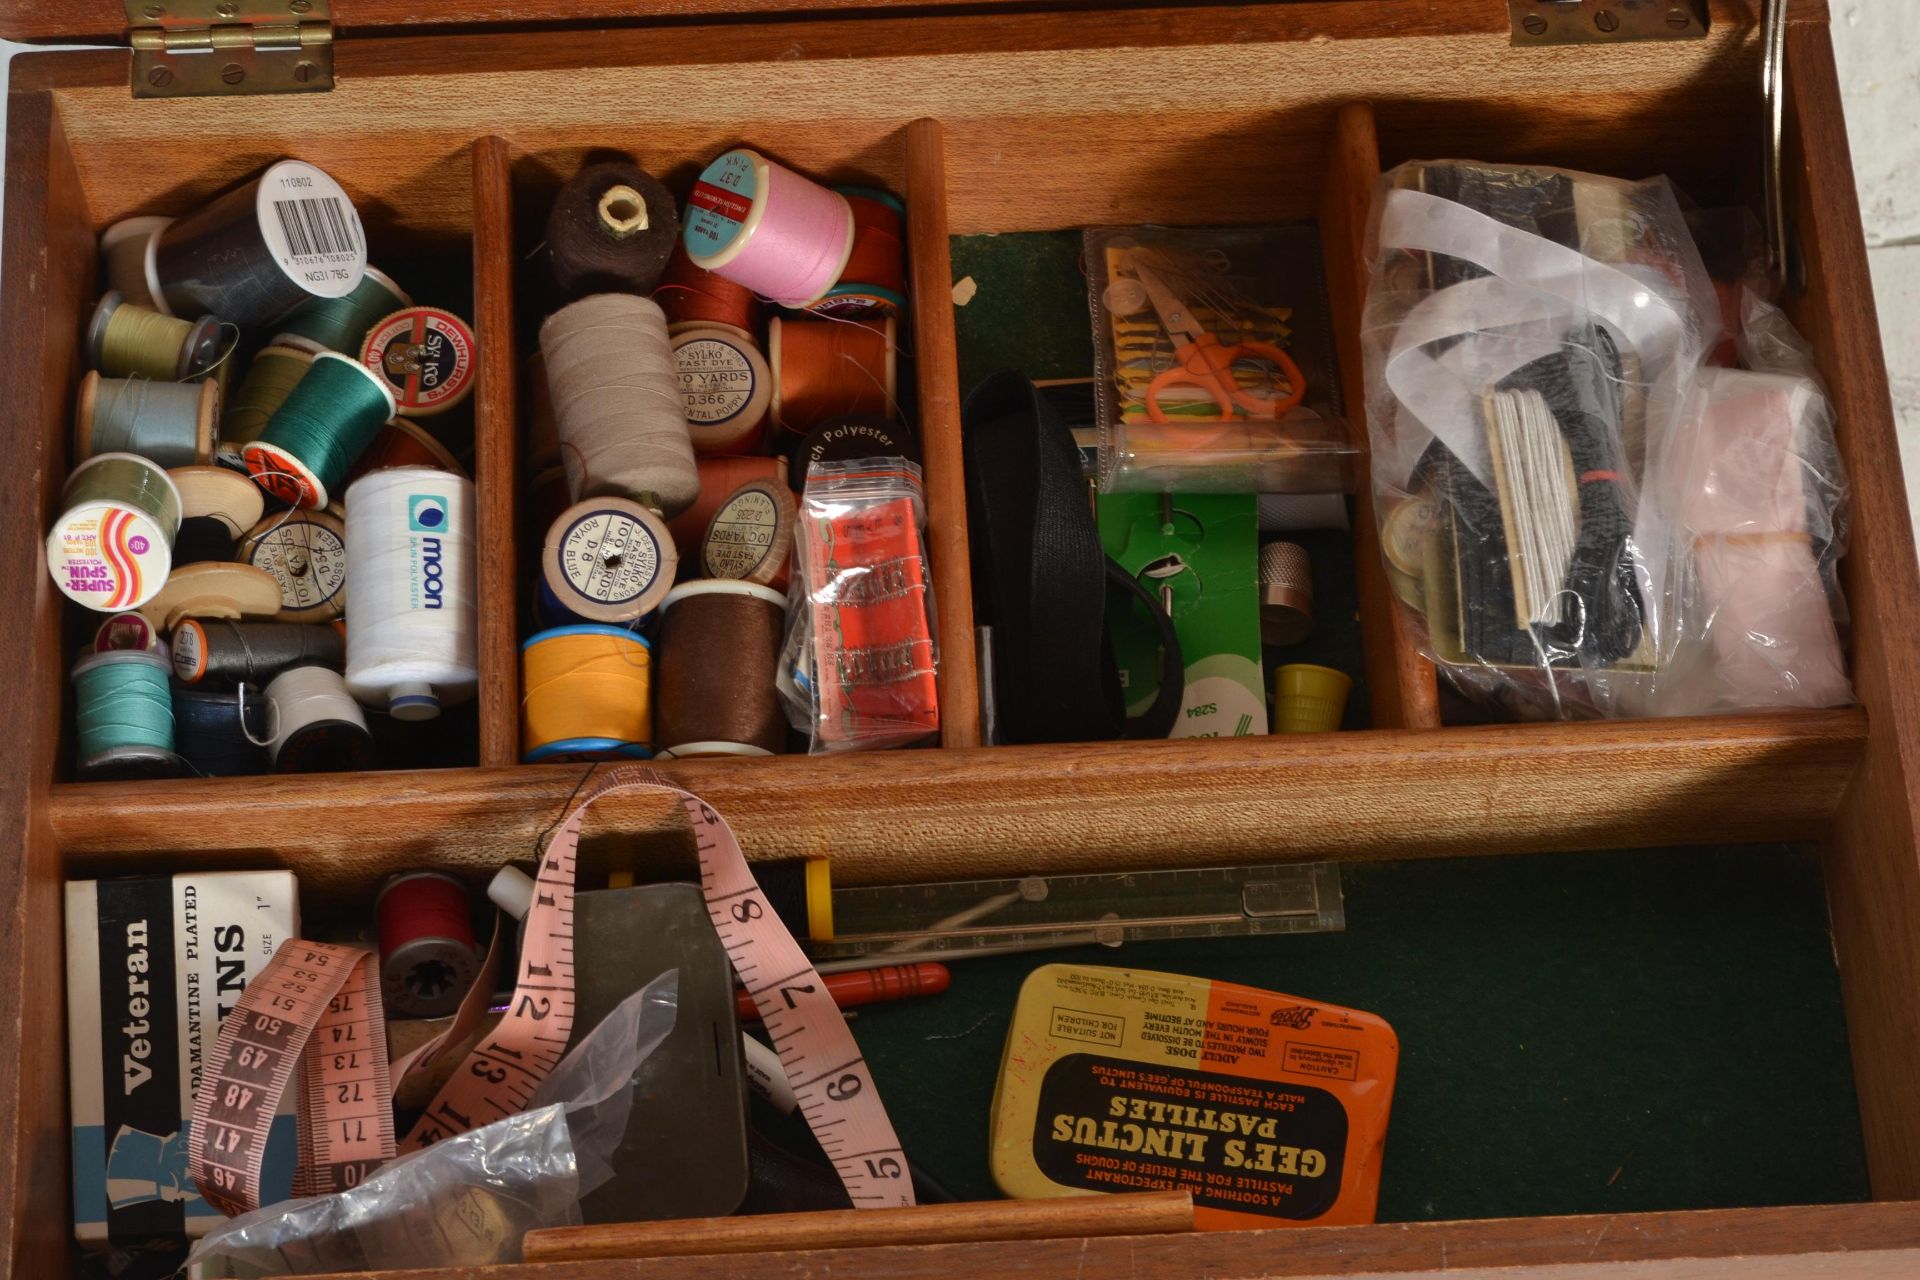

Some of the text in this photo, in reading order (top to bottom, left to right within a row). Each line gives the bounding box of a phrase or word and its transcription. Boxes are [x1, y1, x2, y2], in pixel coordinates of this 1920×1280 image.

[726, 156, 749, 171] PINK
[281, 177, 312, 187] 110802
[708, 230, 720, 241] 100
[332, 269, 348, 278] 7BG
[426, 322, 467, 399] DEWHURST'S
[689, 350, 722, 359] SYLKO
[699, 372, 748, 383] YARDS
[688, 394, 725, 405] D.366
[717, 394, 743, 417] POPPY
[823, 425, 894, 446] Polyester
[615, 520, 632, 549] 100
[712, 530, 745, 542] YARDS
[316, 531, 343, 587] MOSS GREEN
[566, 520, 599, 579] ROYAL BLUE
[582, 539, 598, 563] D.8
[627, 540, 641, 567] FAST
[641, 535, 655, 583] DEWHURST
[716, 550, 754, 559] FAST DYE
[423, 538, 444, 609] moon
[631, 551, 647, 583] SYLKO
[720, 560, 744, 568] SYLKO
[65, 579, 115, 591] SUPER-
[277, 570, 288, 594] FAST
[296, 577, 310, 604] 100
[410, 560, 418, 608] POLYESTER
[619, 569, 631, 590] DYE
[614, 588, 636, 600] SONS
[180, 631, 193, 646] 278
[1186, 703, 1218, 718] S284
[731, 898, 764, 924] 8
[263, 933, 273, 955] SIZE
[304, 951, 330, 966] 54
[281, 981, 308, 994] 52
[292, 970, 319, 983] 53
[185, 885, 201, 1102] ADAMANTINE PLATED
[270, 996, 297, 1010] 51
[328, 994, 354, 1014] 75
[779, 984, 816, 1010] 7
[125, 919, 152, 1096] Veteran
[1269, 1002, 1318, 1032] Boots
[254, 1016, 283, 1036] 50
[1056, 1024, 1117, 1040] NOT SUITABLE
[1057, 1014, 1118, 1030] FOR CHILDREN
[1143, 1011, 1269, 1037] FOUR HOURS AND AT BEDTIME
[333, 1026, 356, 1043] 74
[1140, 1032, 1266, 1057] TWO PASTILLES TO BE DISSOLVED
[1143, 1021, 1268, 1047] SLOWLY IN THE MOUTH EVERY
[238, 1046, 269, 1069] 49
[333, 1055, 359, 1070] 73
[1164, 1045, 1239, 1065] ADULT DOSE
[1300, 1063, 1339, 1075] CAUTION
[337, 1084, 364, 1103] 72
[826, 1073, 862, 1101] 6
[1090, 1064, 1306, 1105] HALF A TEASPOONFUL OF GEE'S LINCTUS
[1099, 1076, 1295, 1112] EACH PASTILLE IS EQUIVALENT TO
[223, 1085, 254, 1110] 48
[1108, 1095, 1280, 1139] PASTILLES
[213, 1128, 242, 1152] 47
[342, 1122, 367, 1144] 71
[1050, 1112, 1329, 1180] GEE'S LINCTUS
[213, 1167, 236, 1191] 46
[343, 1165, 367, 1187] 70
[865, 1156, 901, 1181] 5
[1075, 1153, 1294, 1194] PASTILLE FOR THE RELIEF OF COUGHS
[1085, 1168, 1281, 1207] A SOOTHING AND EXPECTORANT
